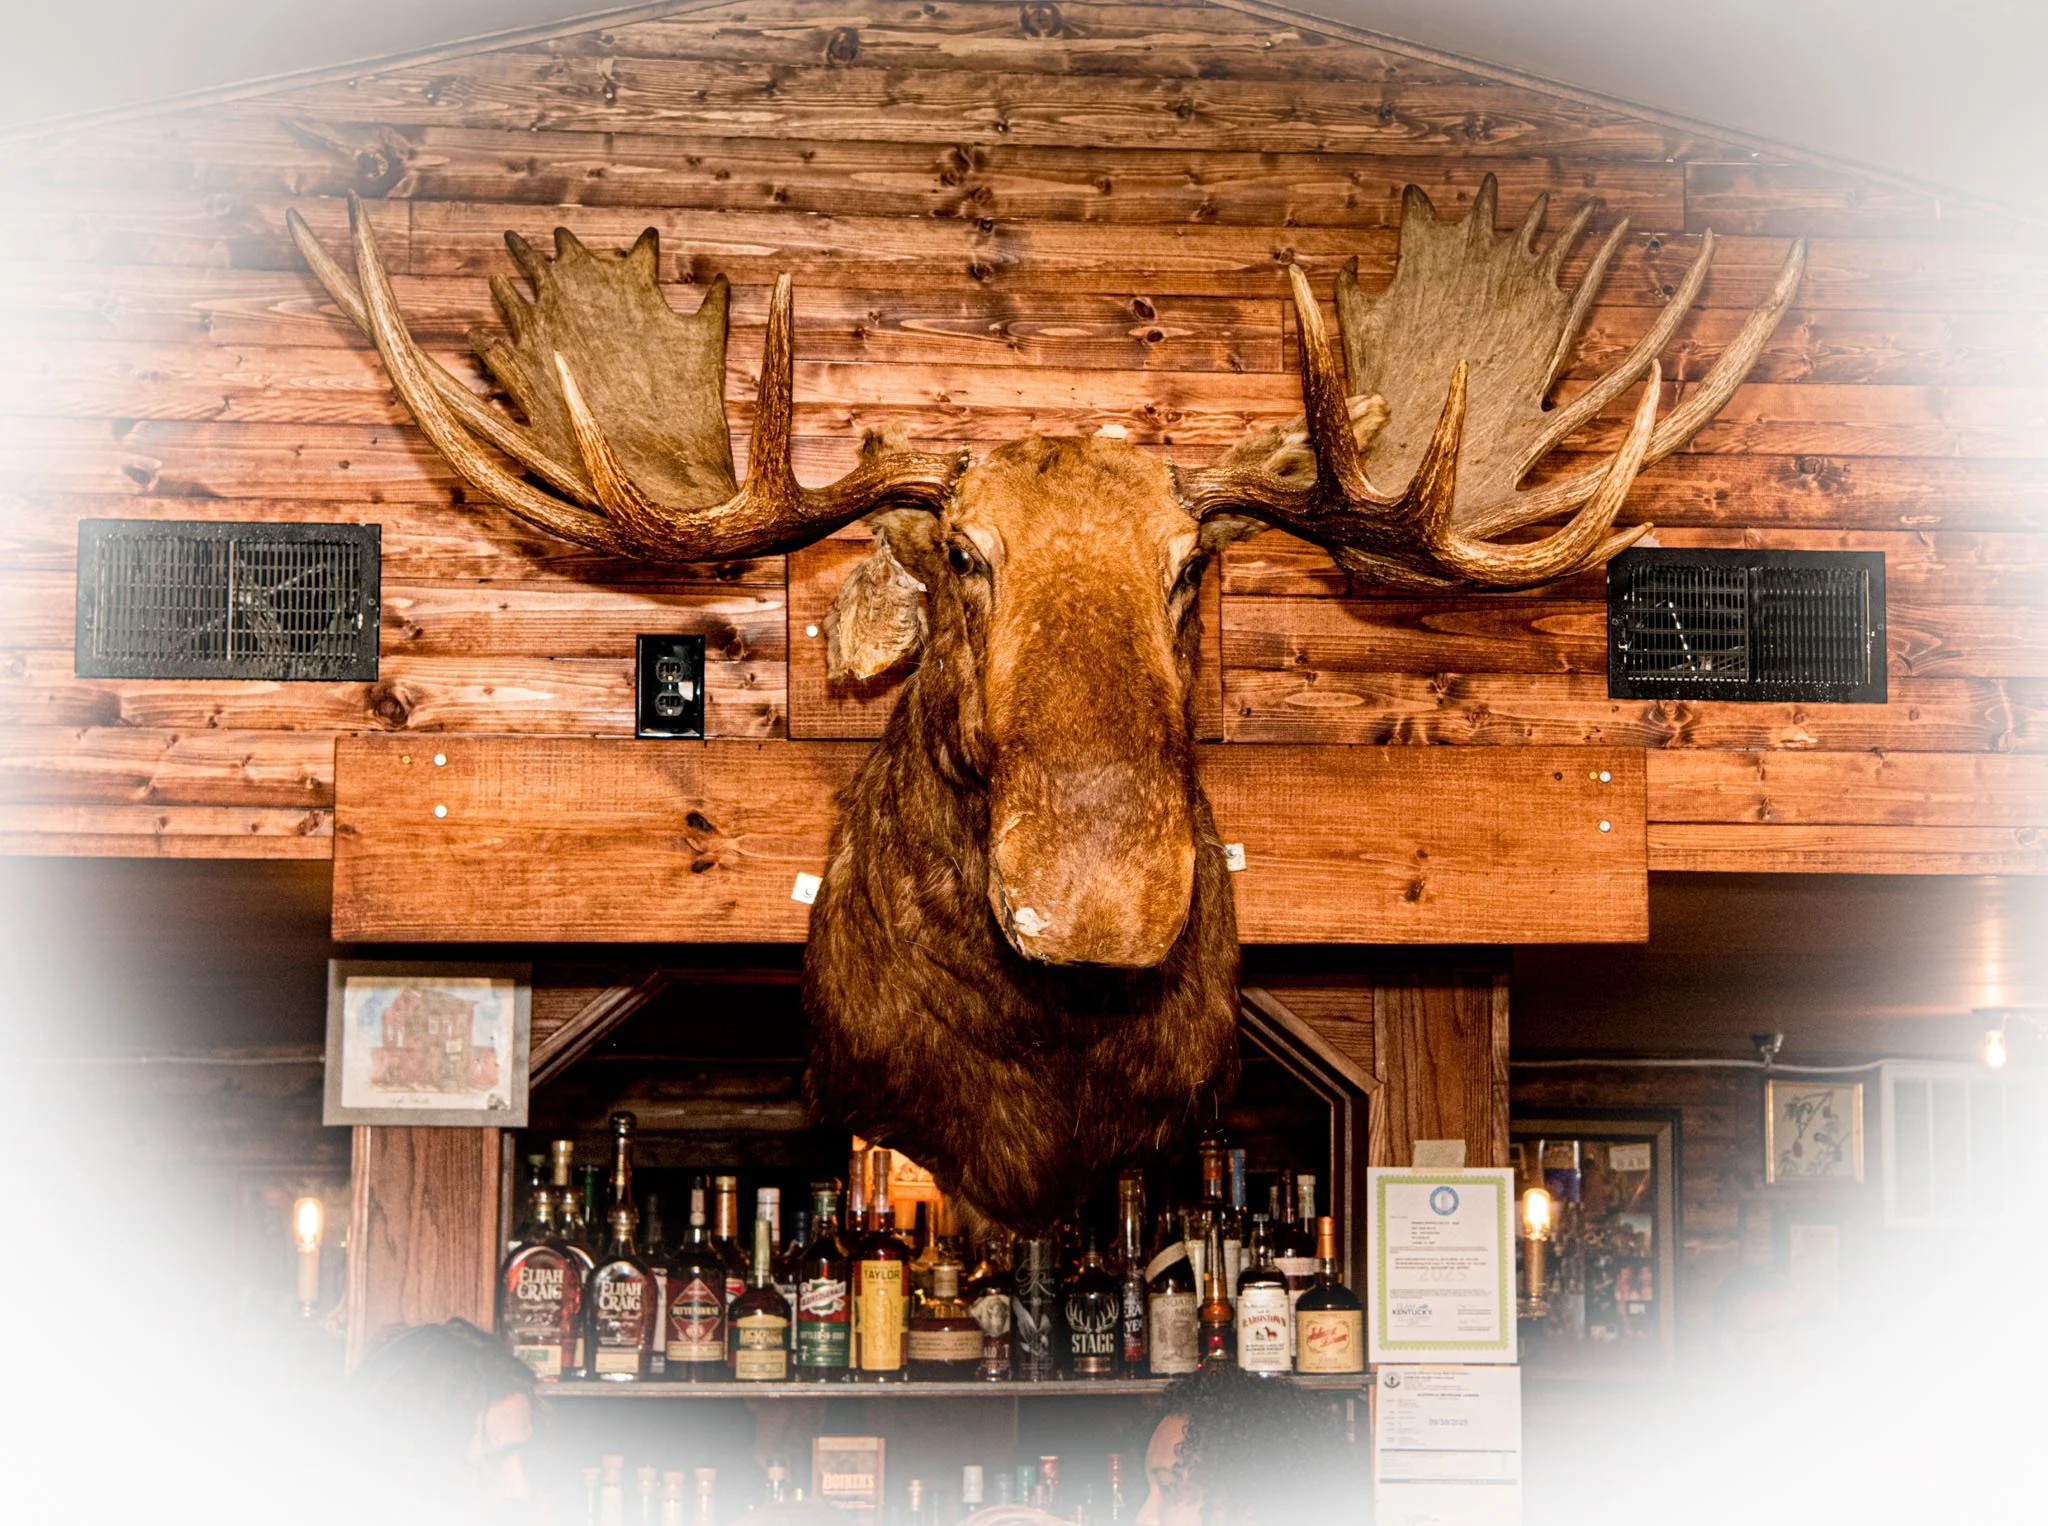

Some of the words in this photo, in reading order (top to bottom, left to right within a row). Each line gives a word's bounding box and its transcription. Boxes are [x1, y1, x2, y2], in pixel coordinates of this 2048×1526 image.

[518, 1267, 565, 1284] ELIJAH
[863, 1269, 901, 1281] TAYLOR
[516, 1283, 564, 1301] CRAIG
[600, 1281, 643, 1297] ELIJAH
[598, 1295, 642, 1312] CRAIG
[1392, 1308, 1433, 1316] KENTUCKY
[1071, 1333, 1115, 1354] STAGG
